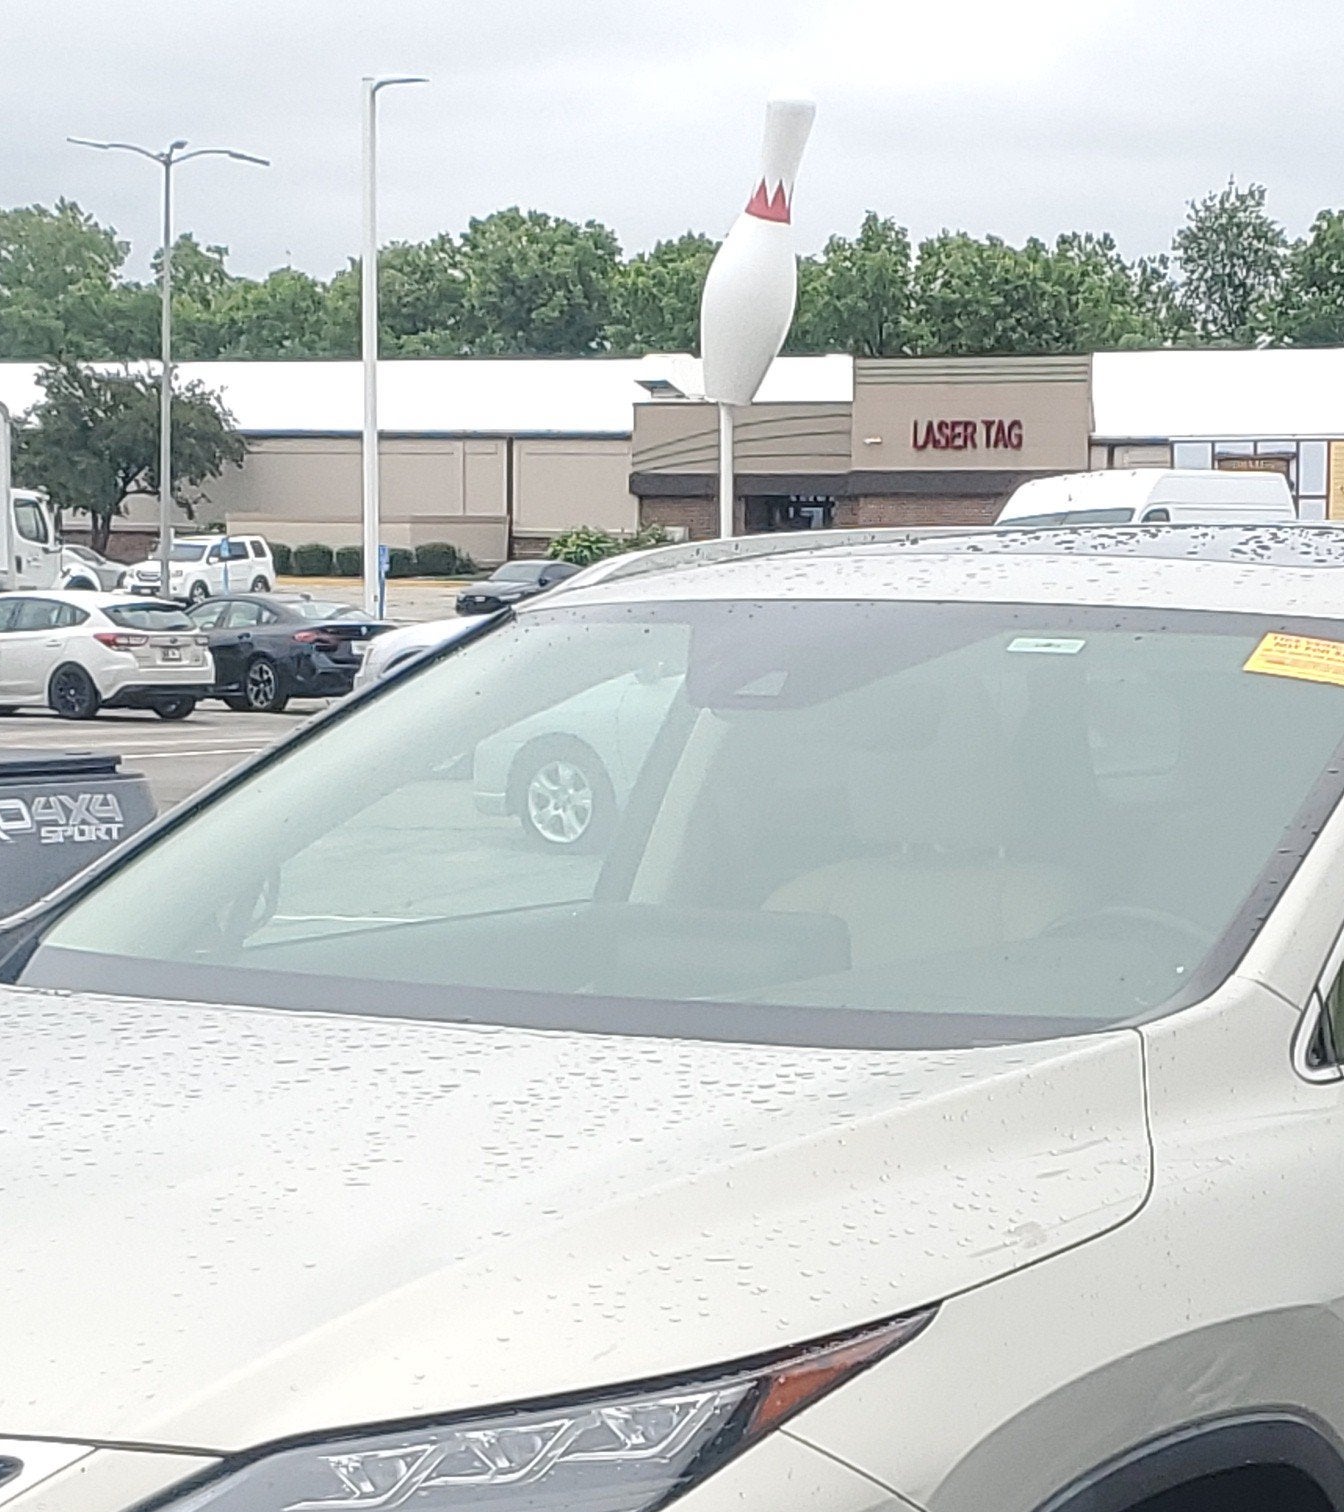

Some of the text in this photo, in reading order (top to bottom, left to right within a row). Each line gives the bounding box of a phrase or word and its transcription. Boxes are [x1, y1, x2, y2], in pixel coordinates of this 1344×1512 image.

[912, 419, 1023, 451] LASER TAG
[32, 793, 124, 826] 4X4
[41, 823, 124, 844] SPORT
